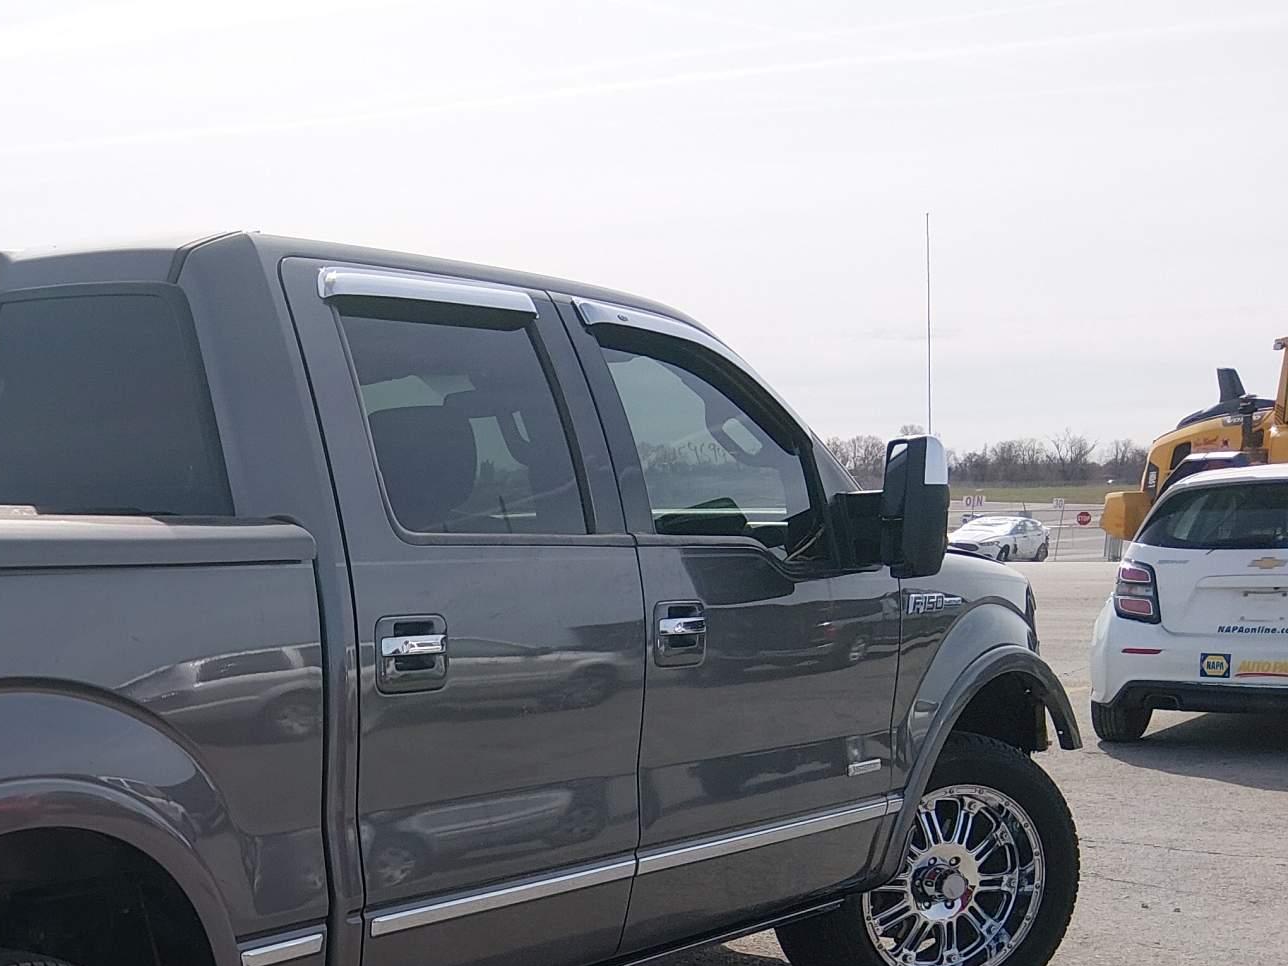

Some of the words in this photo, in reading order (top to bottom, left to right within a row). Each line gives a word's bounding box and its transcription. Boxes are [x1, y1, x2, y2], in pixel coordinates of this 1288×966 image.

[1077, 514, 1091, 523] STOP
[1207, 661, 1225, 670] NAPA
[1238, 661, 1272, 673] AUTO
